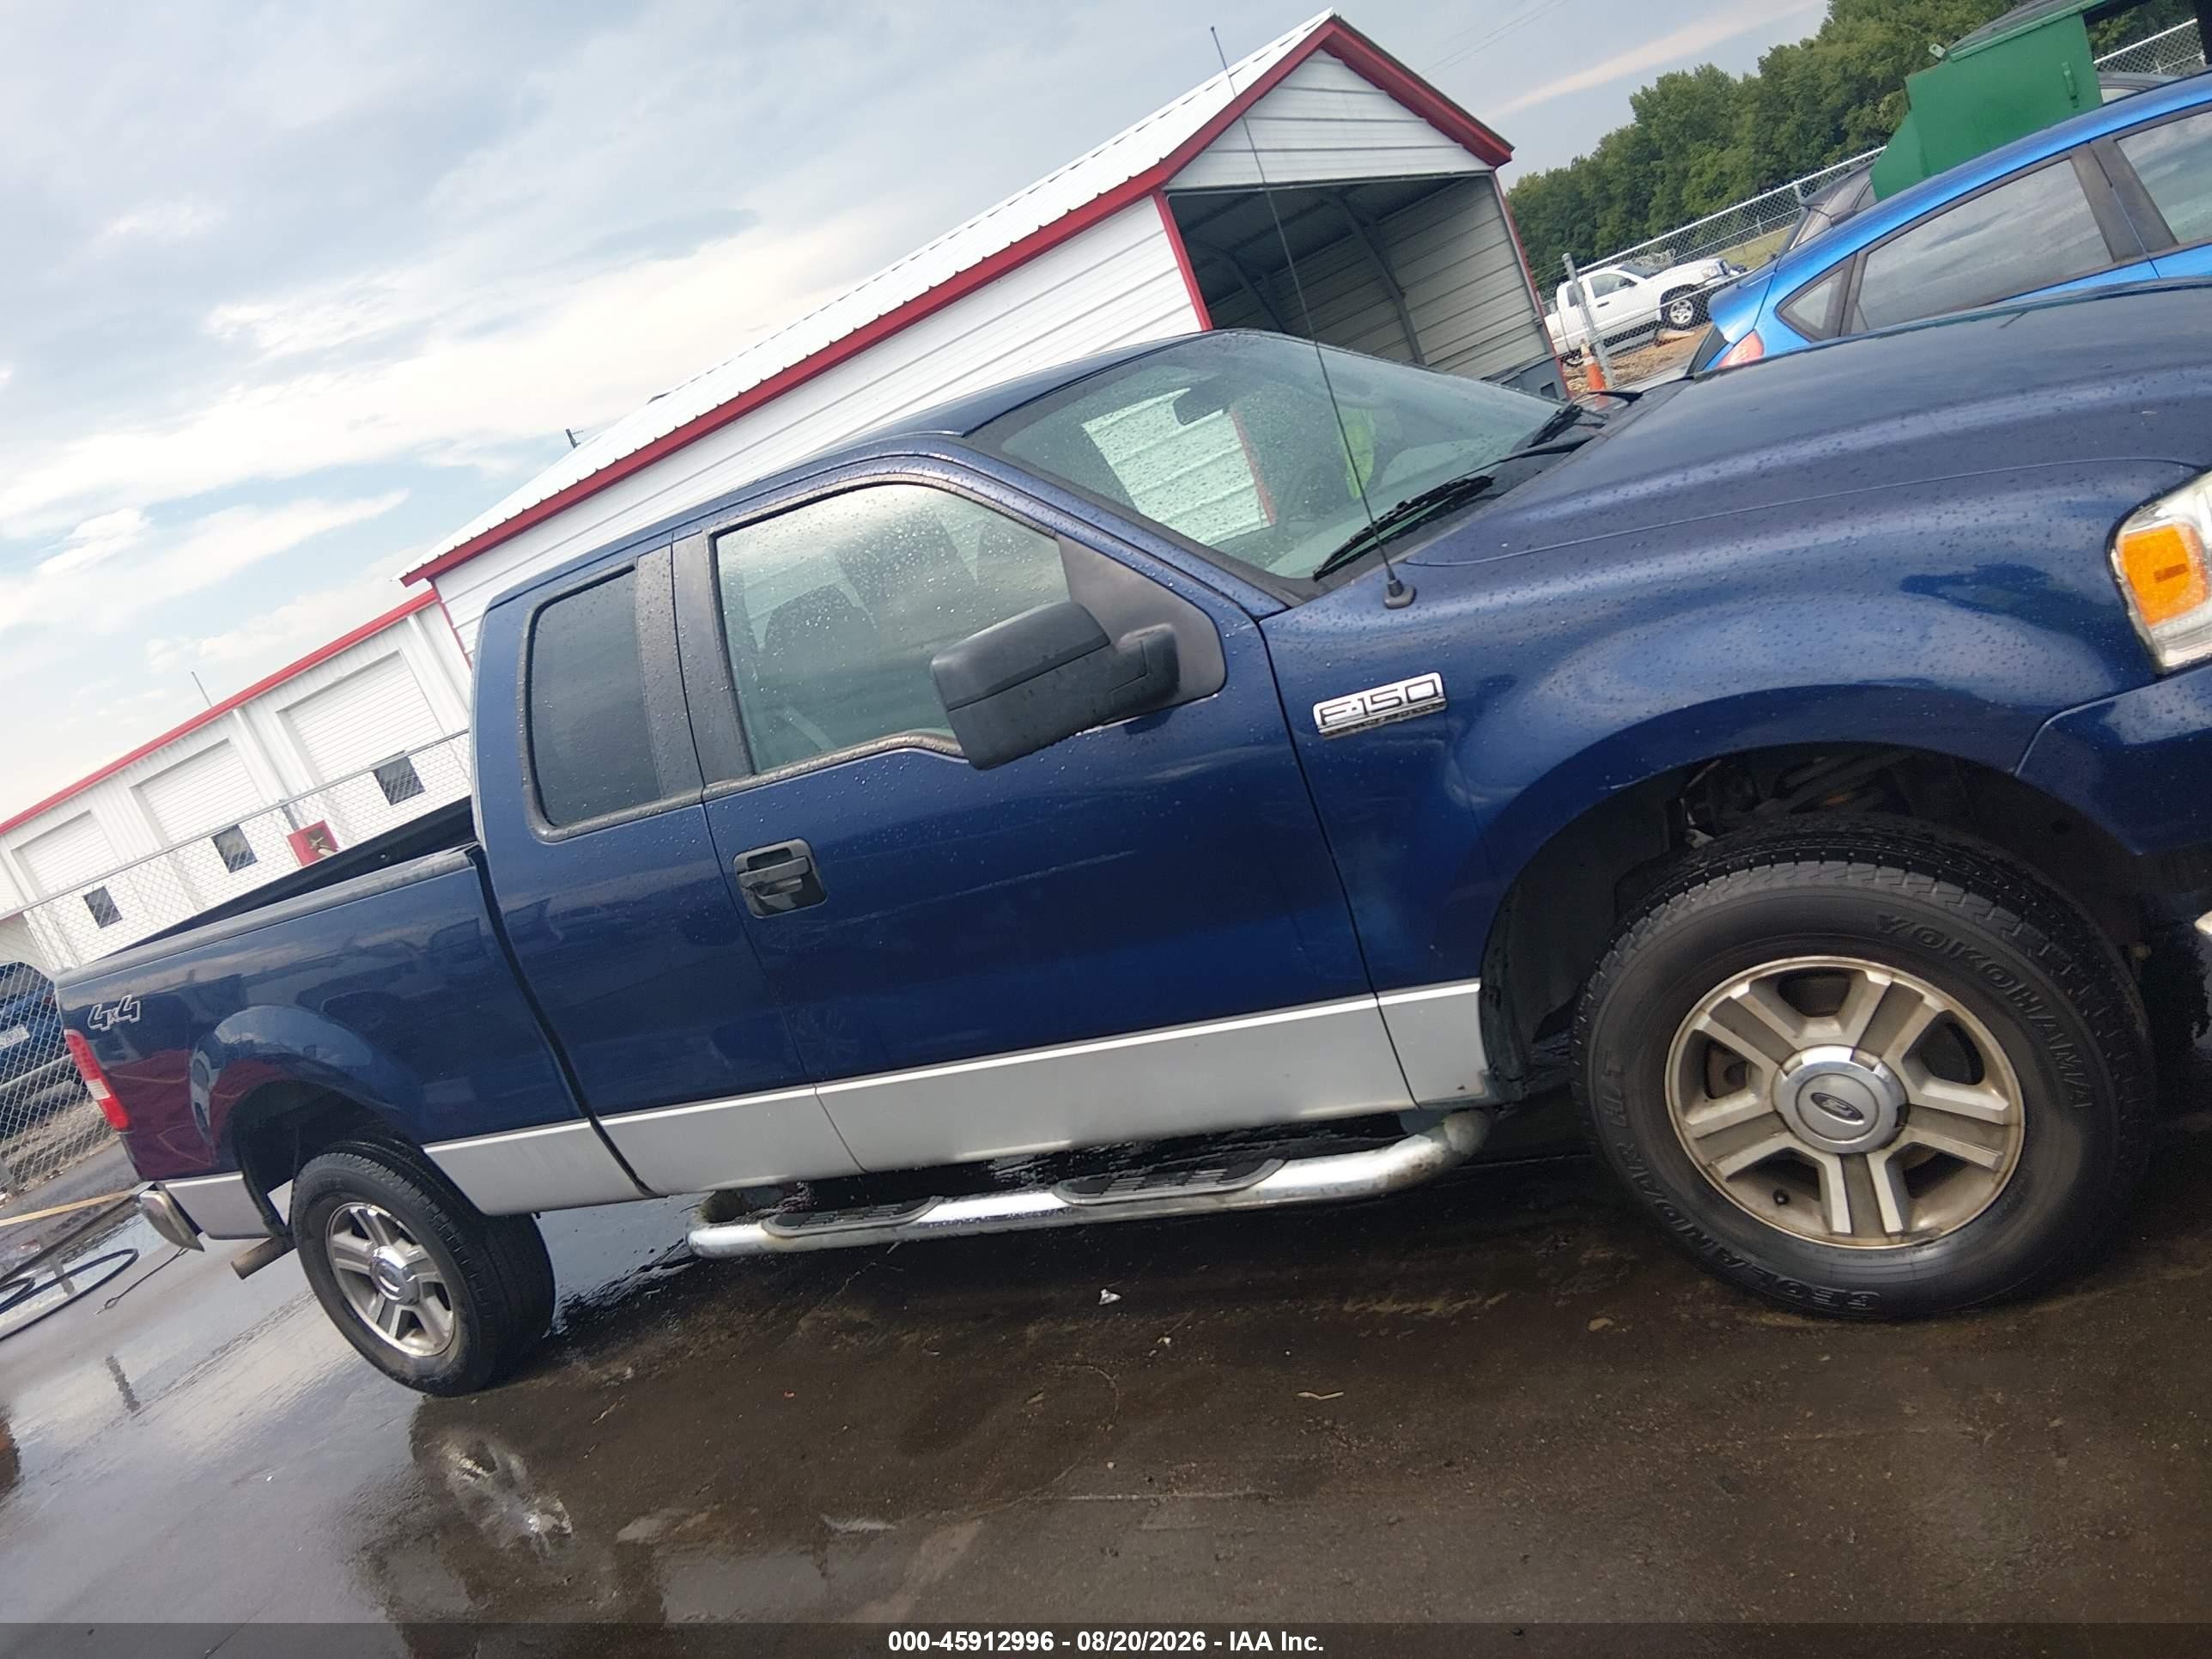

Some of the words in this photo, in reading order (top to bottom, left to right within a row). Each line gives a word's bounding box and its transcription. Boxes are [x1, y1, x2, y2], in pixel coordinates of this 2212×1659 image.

[1316, 676, 1442, 728] F-150
[88, 995, 141, 1031] 4x4
[1877, 913, 2094, 1108] YOKOHAMA
